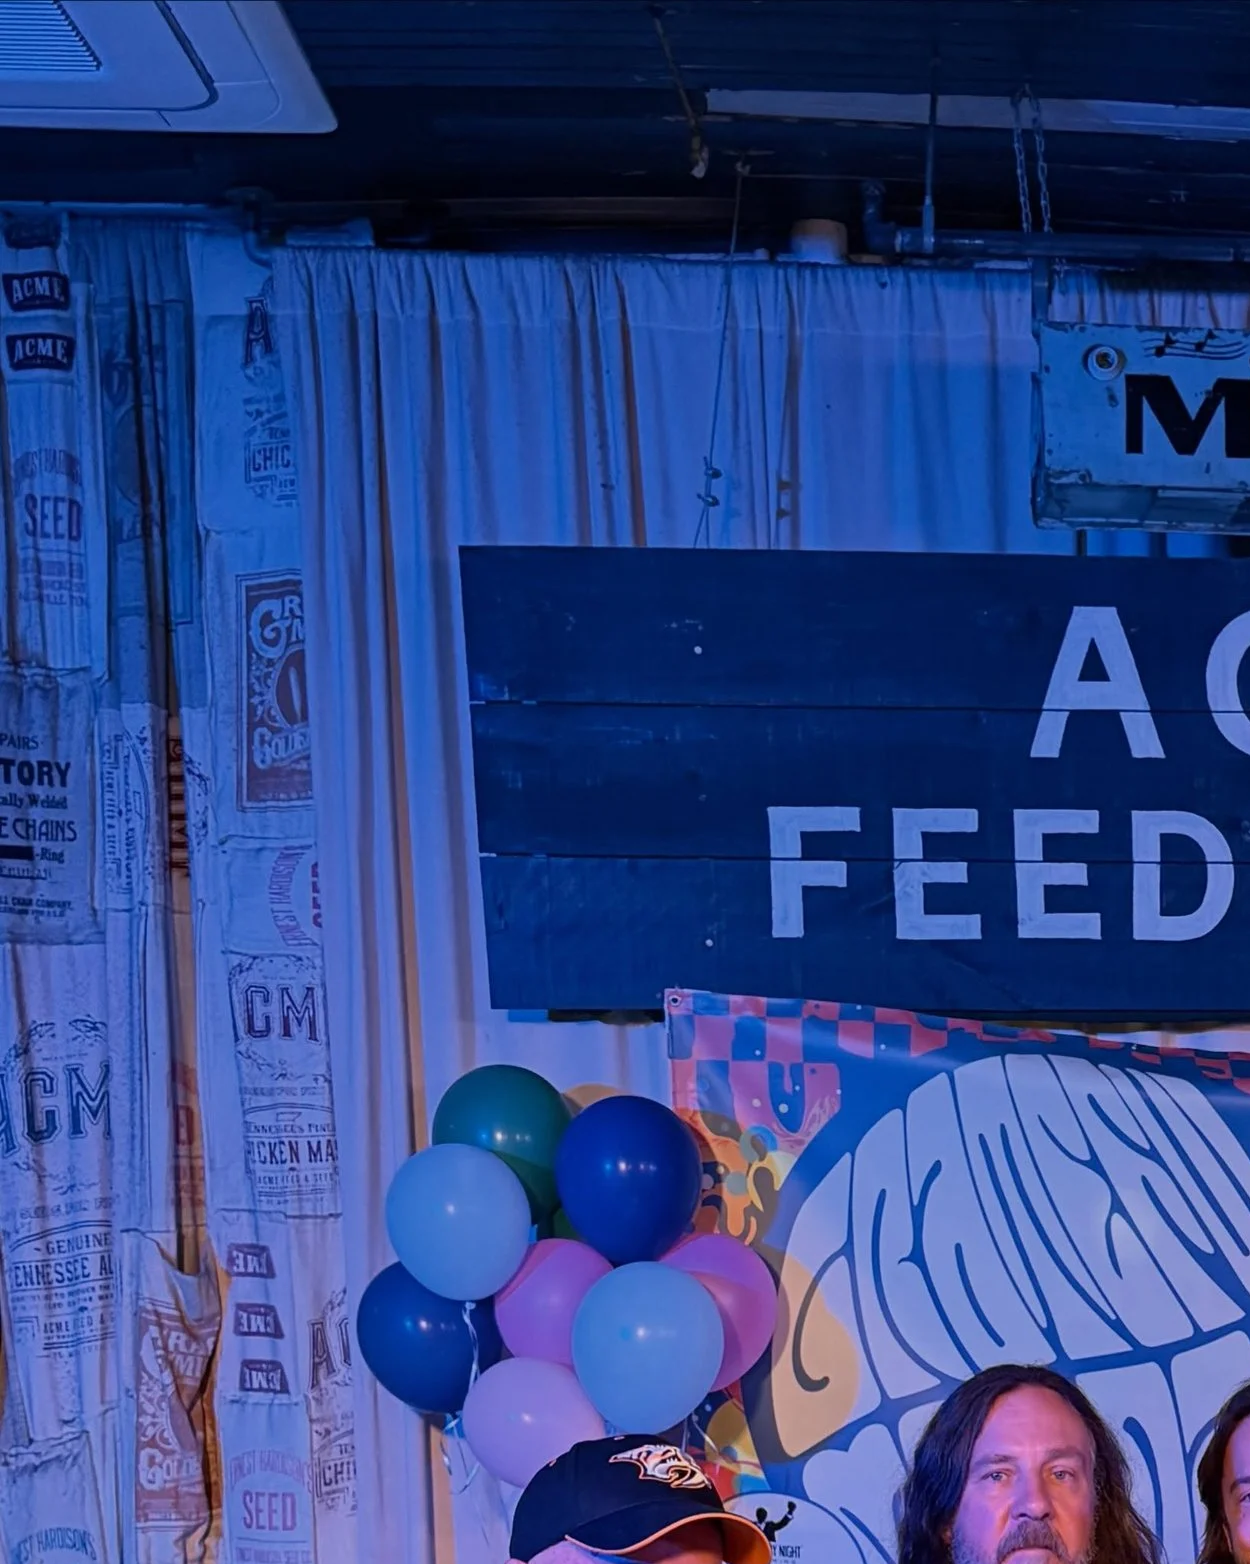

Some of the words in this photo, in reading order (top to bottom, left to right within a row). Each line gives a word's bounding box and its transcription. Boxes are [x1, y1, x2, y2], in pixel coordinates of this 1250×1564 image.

[12, 275, 65, 303] ACME
[14, 338, 67, 363] ACME
[24, 493, 83, 542] SEED
[0, 757, 71, 788] TORY
[12, 818, 77, 844] CHAINS
[767, 806, 1235, 941] FEED
[46, 1231, 113, 1255] GENUINE
[10, 1256, 91, 1289] ENNESSEE
[242, 1489, 297, 1531] SEED
[779, 1545, 802, 1560] NIGHT
